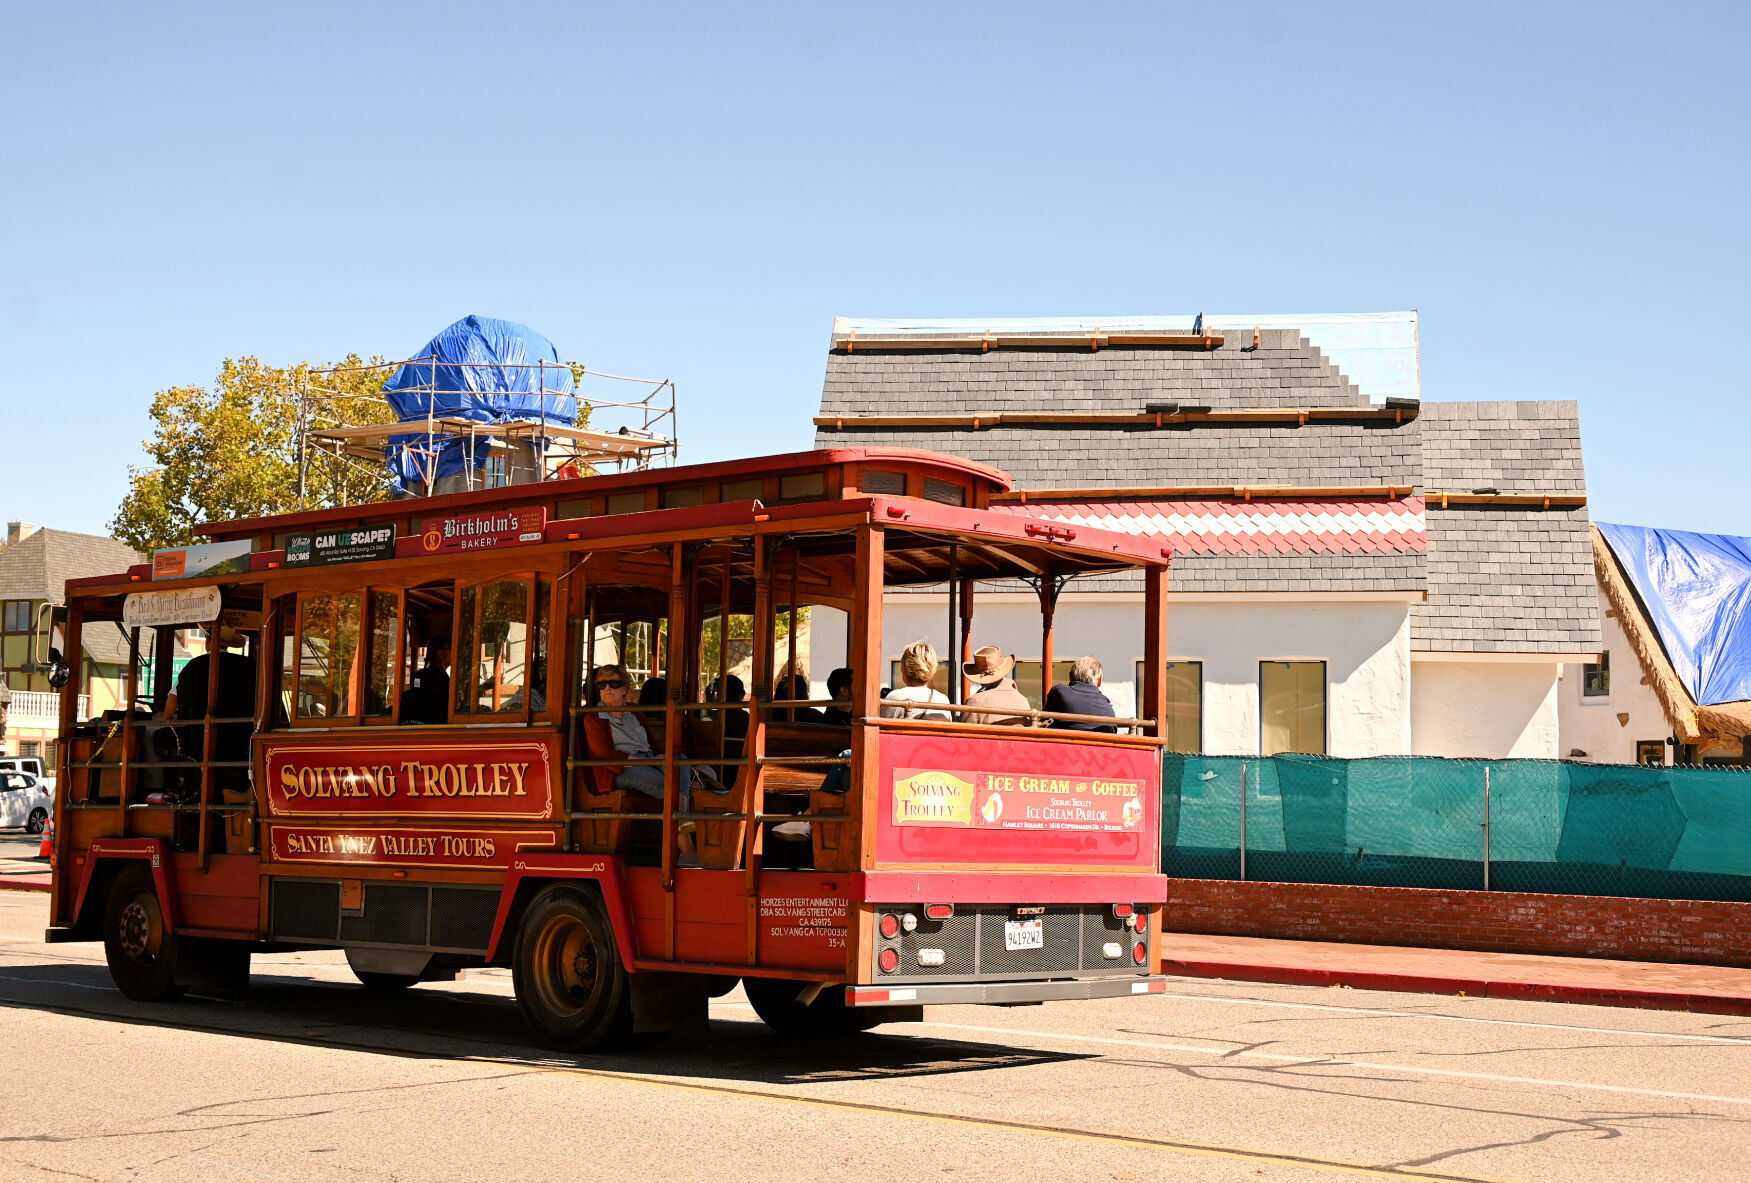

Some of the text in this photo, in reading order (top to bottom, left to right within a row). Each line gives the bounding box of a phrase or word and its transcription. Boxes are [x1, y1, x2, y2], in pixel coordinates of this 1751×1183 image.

[443, 512, 518, 540] Birkholm's
[315, 534, 336, 548] CAN
[462, 537, 498, 549] BAKERY
[288, 544, 311, 554] ESCAPE
[287, 552, 310, 563] ROOMS
[280, 760, 530, 800] SOLVANG TROLLEY
[988, 775, 1014, 792] ICE
[1020, 776, 1070, 794] CREAM
[1092, 780, 1138, 796] COFFEE
[908, 780, 961, 798] SOLVANG
[902, 800, 954, 817] TROLLEY
[1026, 805, 1108, 821] ICE CREAM PARLOR
[287, 833, 495, 858] SANTA YNEZ VALLEY TOURS
[761, 898, 785, 906] HORZES
[786, 898, 837, 906] ENTERTAINMENT
[760, 908, 846, 917] DBA SOLVANG STREETCARS
[799, 918, 831, 926] CA 439175
[771, 928, 804, 936] SOLVANG
[805, 928, 815, 936] CA
[1008, 930, 1041, 946] 94192W2
[829, 938, 846, 947] 35-A
